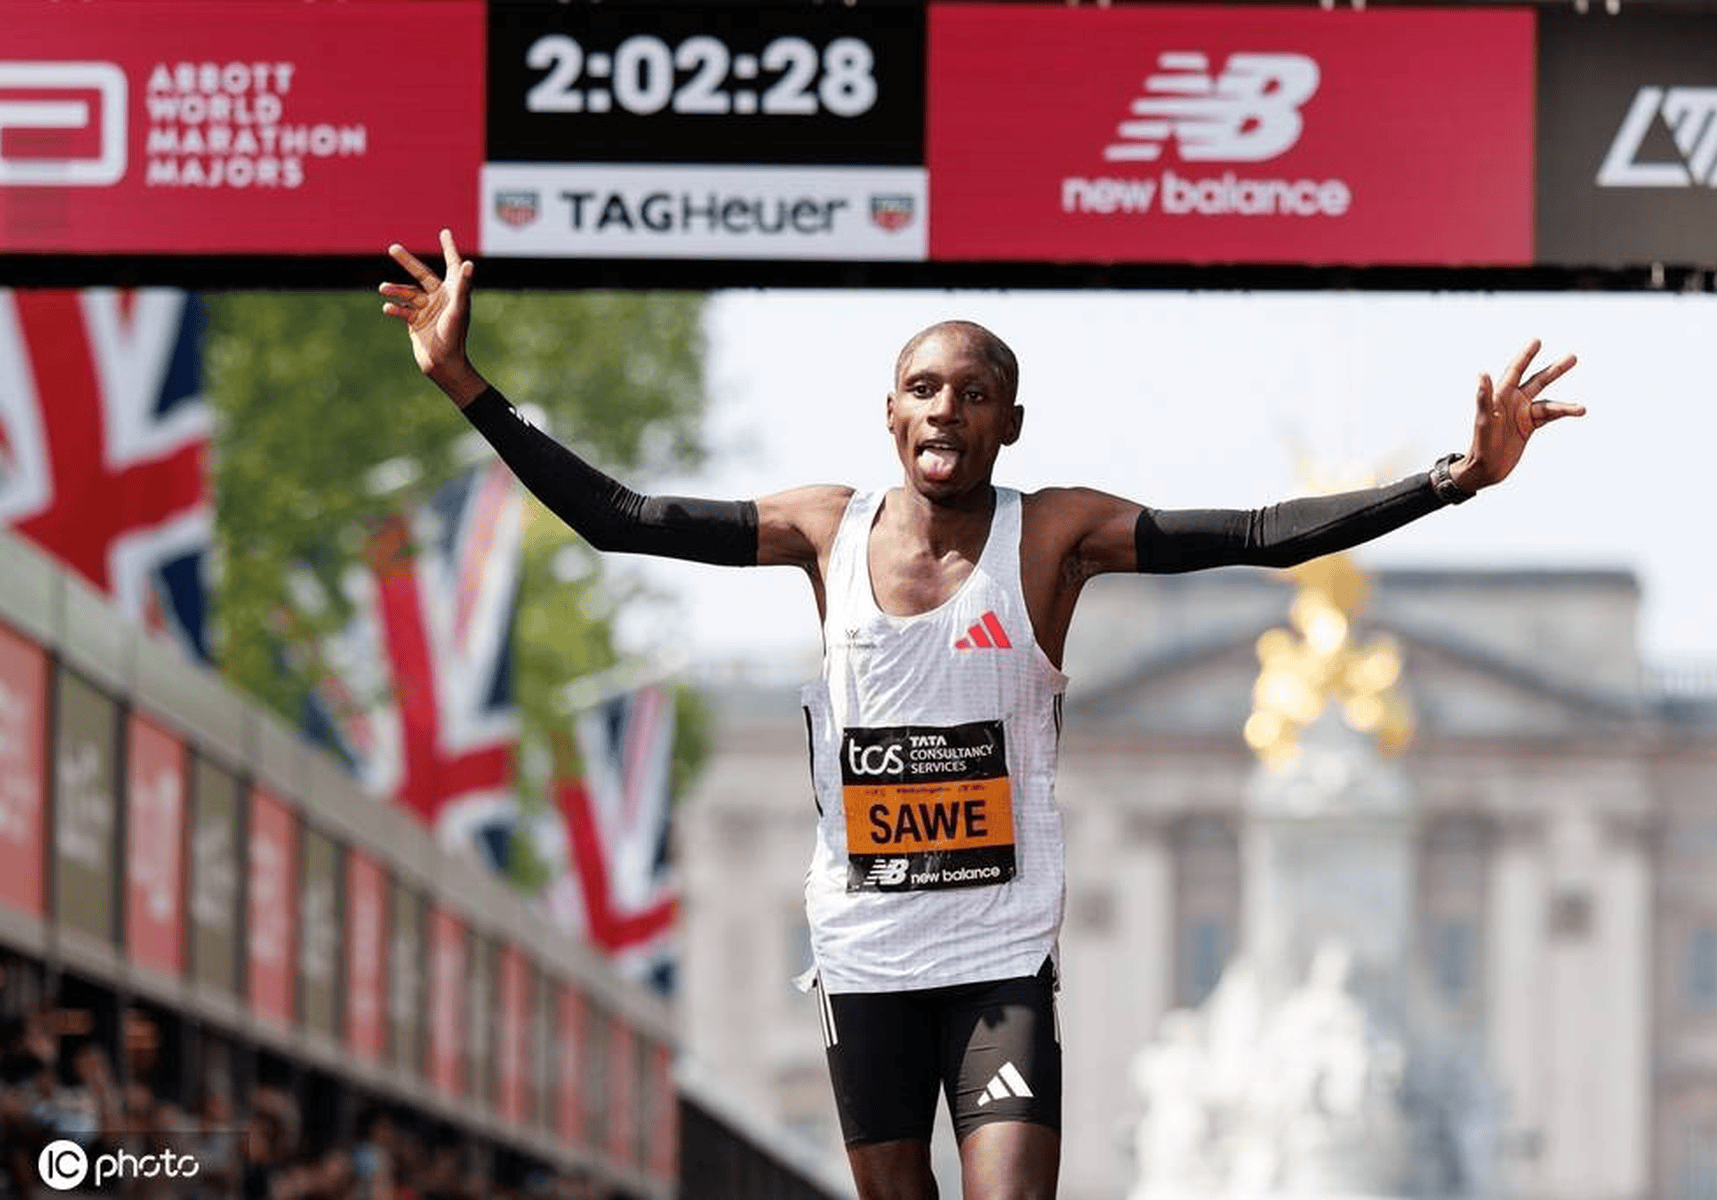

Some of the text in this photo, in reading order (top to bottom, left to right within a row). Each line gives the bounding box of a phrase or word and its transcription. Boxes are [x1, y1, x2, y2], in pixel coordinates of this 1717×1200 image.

[147, 62, 294, 93] ABBOTT
[526, 34, 878, 116] 2:02:28
[147, 94, 282, 125] WORLD
[146, 125, 366, 156] MARATHON
[146, 158, 303, 188] MAJORS
[1062, 172, 1351, 216] new balance
[849, 738, 904, 775] tcs
[910, 736, 947, 747] TATA
[910, 744, 993, 761] CONSULTANCY
[911, 760, 967, 774] SERVICES
[869, 799, 988, 844] SAWE
[911, 866, 1000, 884] new balance
